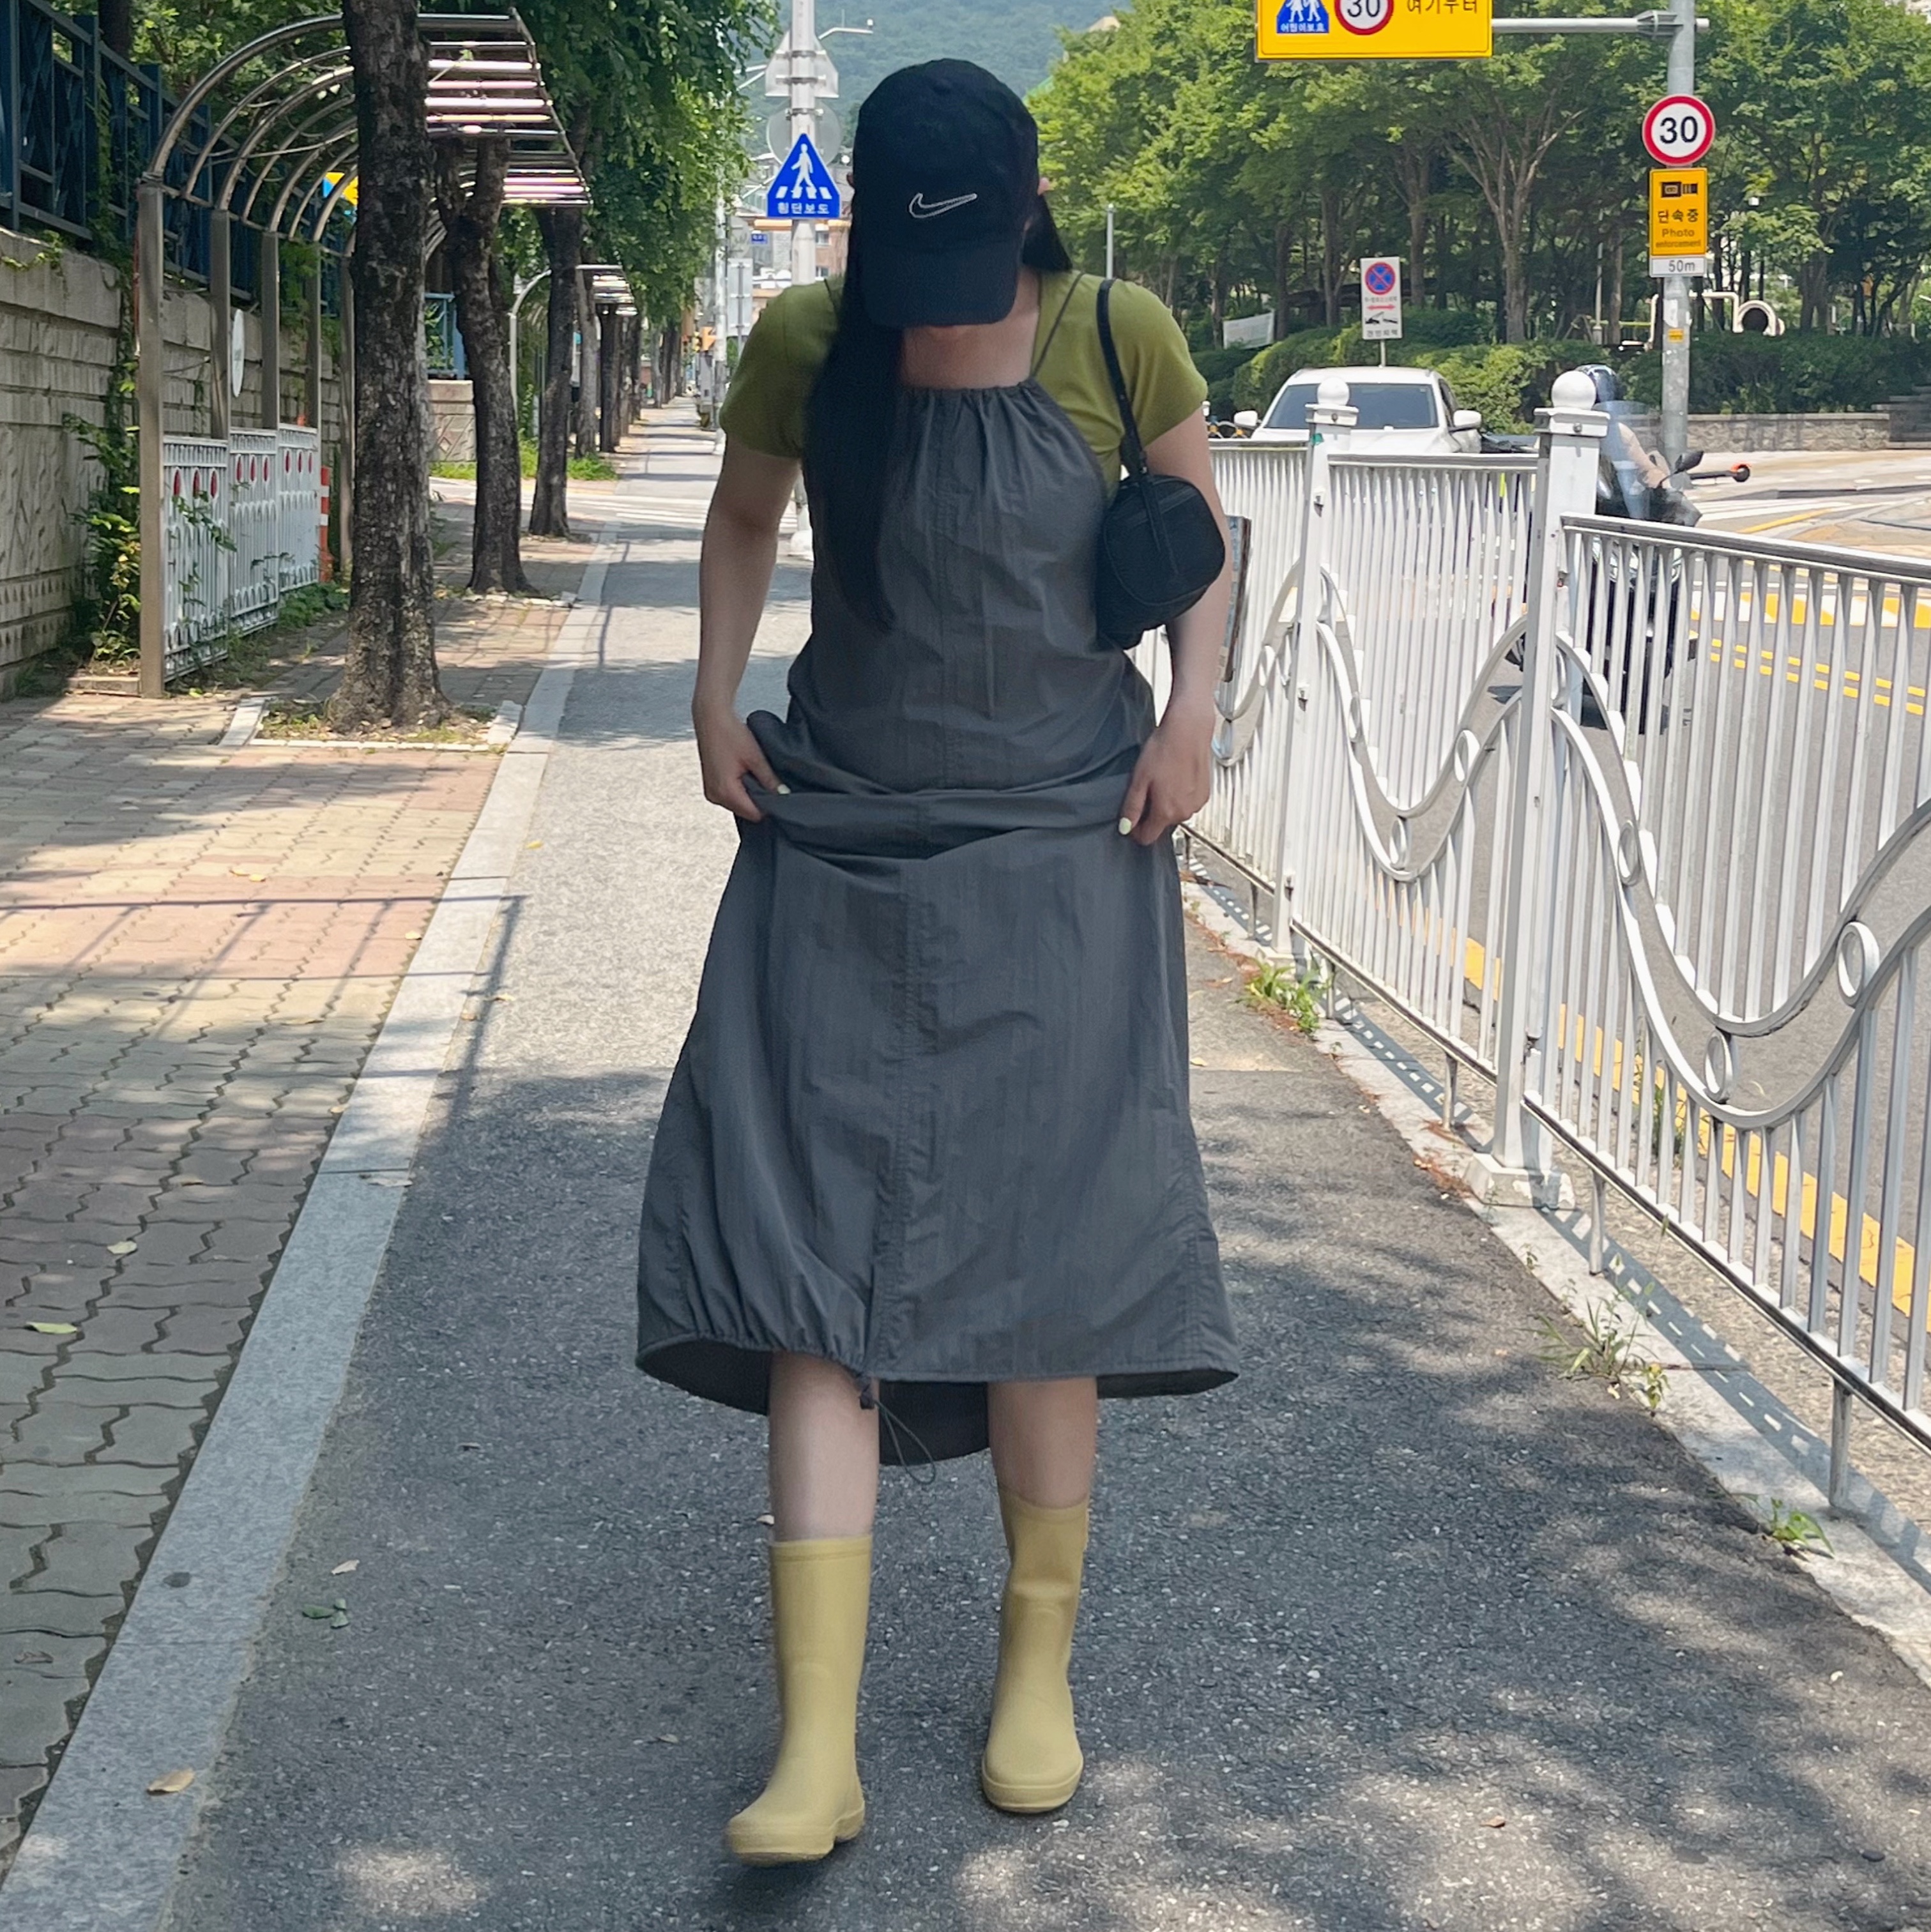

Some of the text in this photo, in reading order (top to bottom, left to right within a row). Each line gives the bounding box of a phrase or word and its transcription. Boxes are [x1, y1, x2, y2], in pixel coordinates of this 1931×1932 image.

[1347, 0, 1381, 18] 30
[1660, 116, 1698, 144] 30
[777, 202, 830, 214] 횡단보도
[1658, 209, 1700, 224] 단속중
[1661, 228, 1695, 238] Photo
[1668, 259, 1696, 273] 50m
